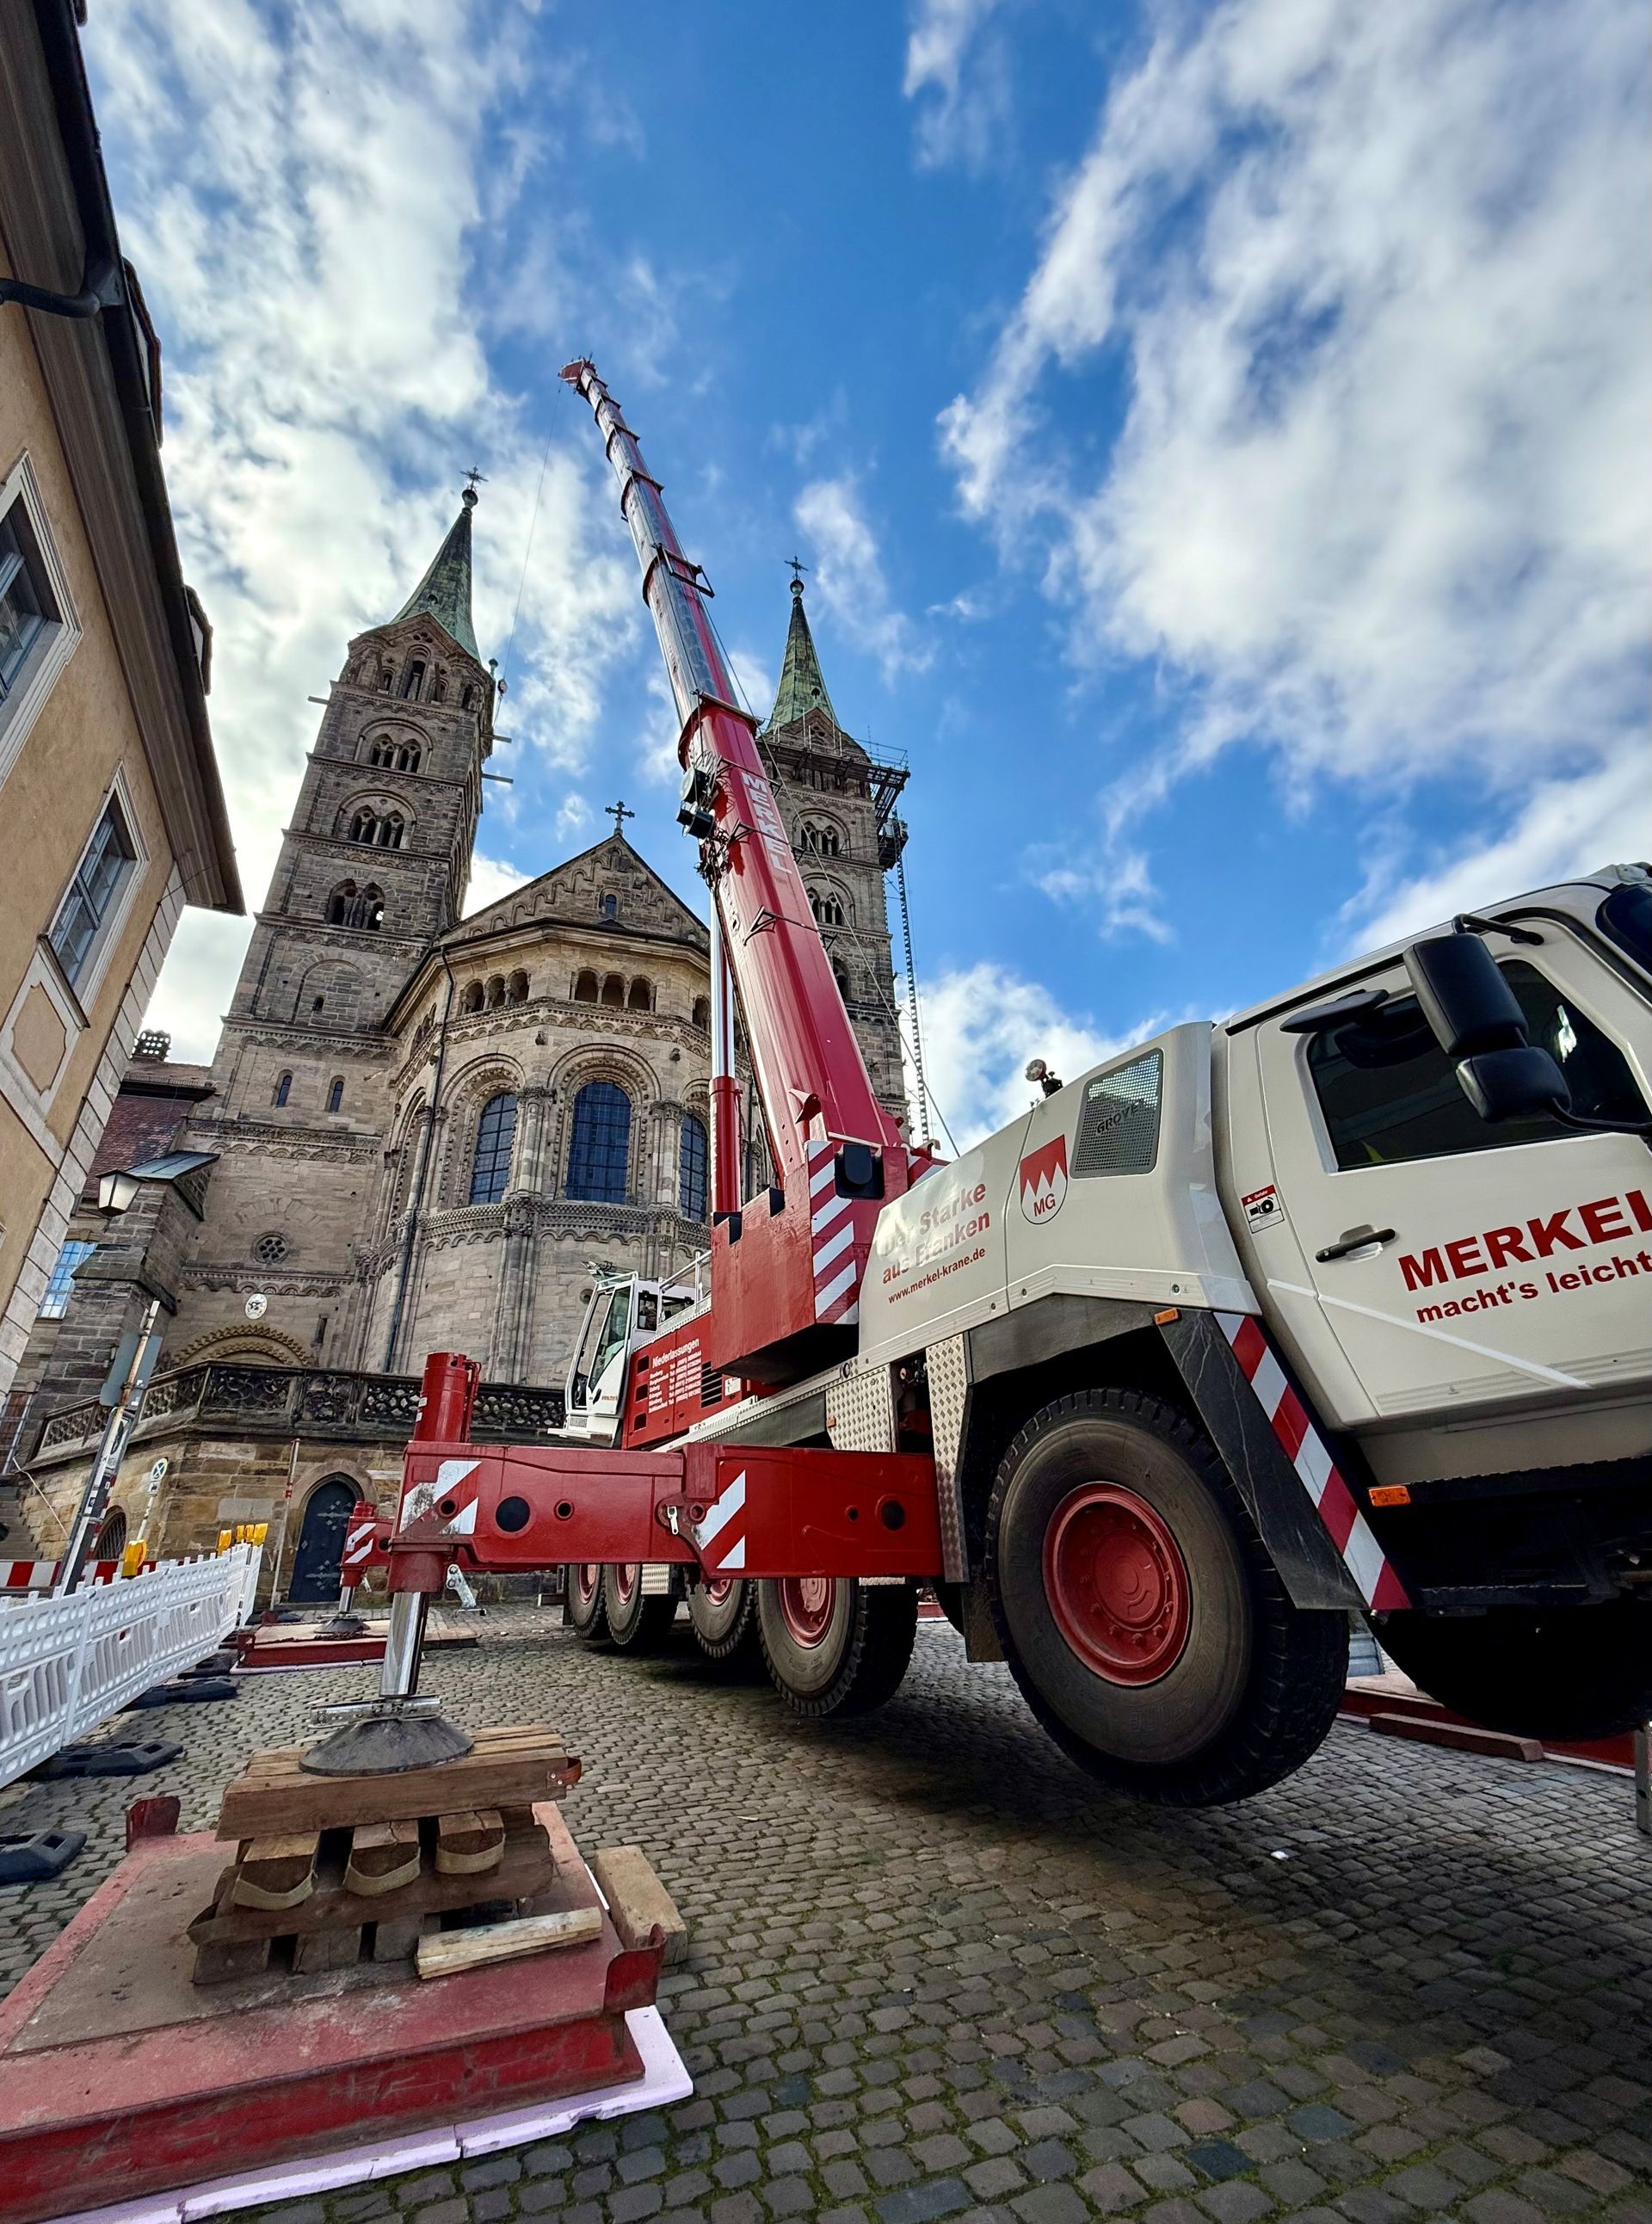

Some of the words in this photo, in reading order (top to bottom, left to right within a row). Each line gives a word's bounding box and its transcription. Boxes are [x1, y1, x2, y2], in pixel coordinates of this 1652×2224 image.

[743, 772, 792, 874] MERKEL
[1096, 1102, 1140, 1134] GROVE
[920, 1183, 986, 1236] Starke
[1033, 1192, 1056, 1217] MG
[883, 1257, 910, 1284] aus
[915, 1212, 989, 1267] Franken
[1398, 1190, 1652, 1291] MERKEL
[889, 1248, 985, 1303] www.merkel-krane.de
[1416, 1281, 1539, 1323] macht's
[1545, 1251, 1652, 1294] leicht
[652, 1338, 700, 1368] Niederlassungen
